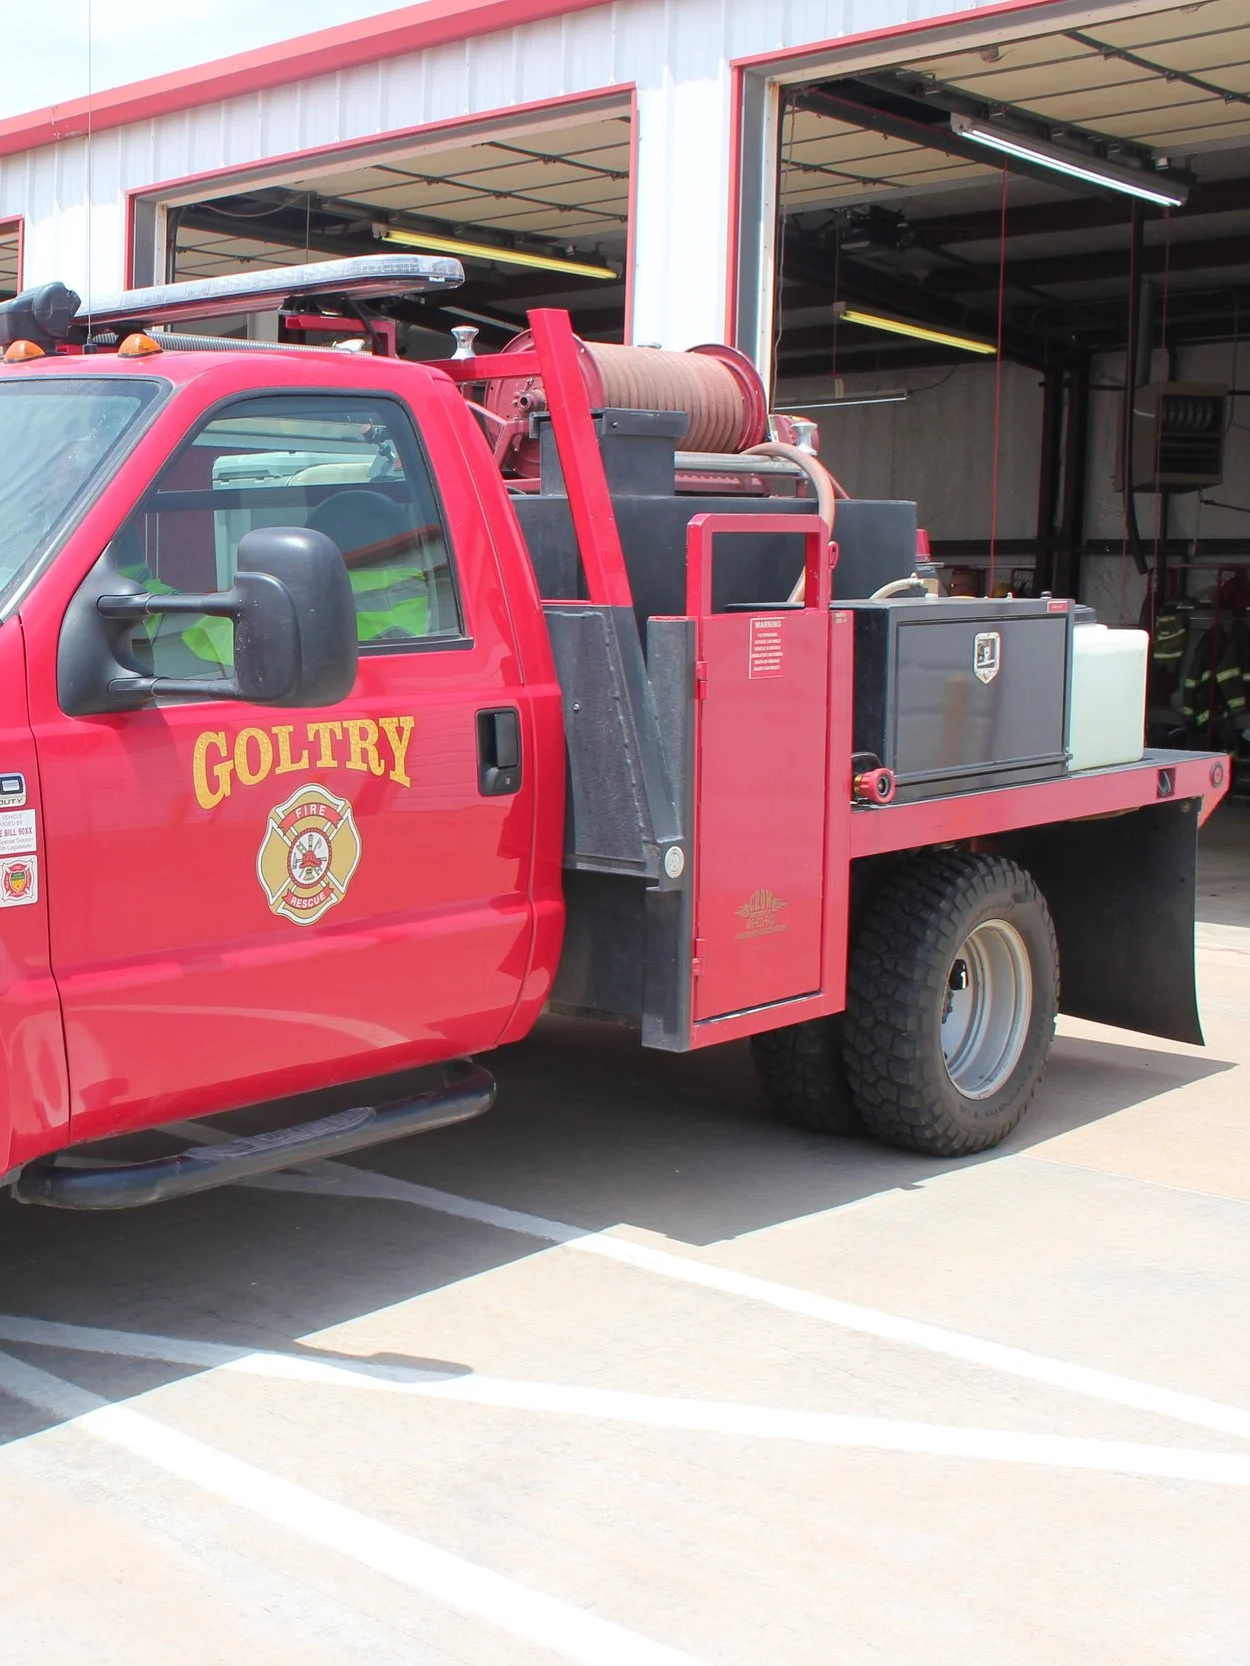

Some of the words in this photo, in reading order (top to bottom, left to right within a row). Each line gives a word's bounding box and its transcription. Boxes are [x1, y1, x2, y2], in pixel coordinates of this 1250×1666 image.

[192, 715, 415, 810] GOLTRY
[294, 804, 327, 820] FIRE
[4, 829, 17, 838] BILL
[290, 892, 326, 909] RESCUE
